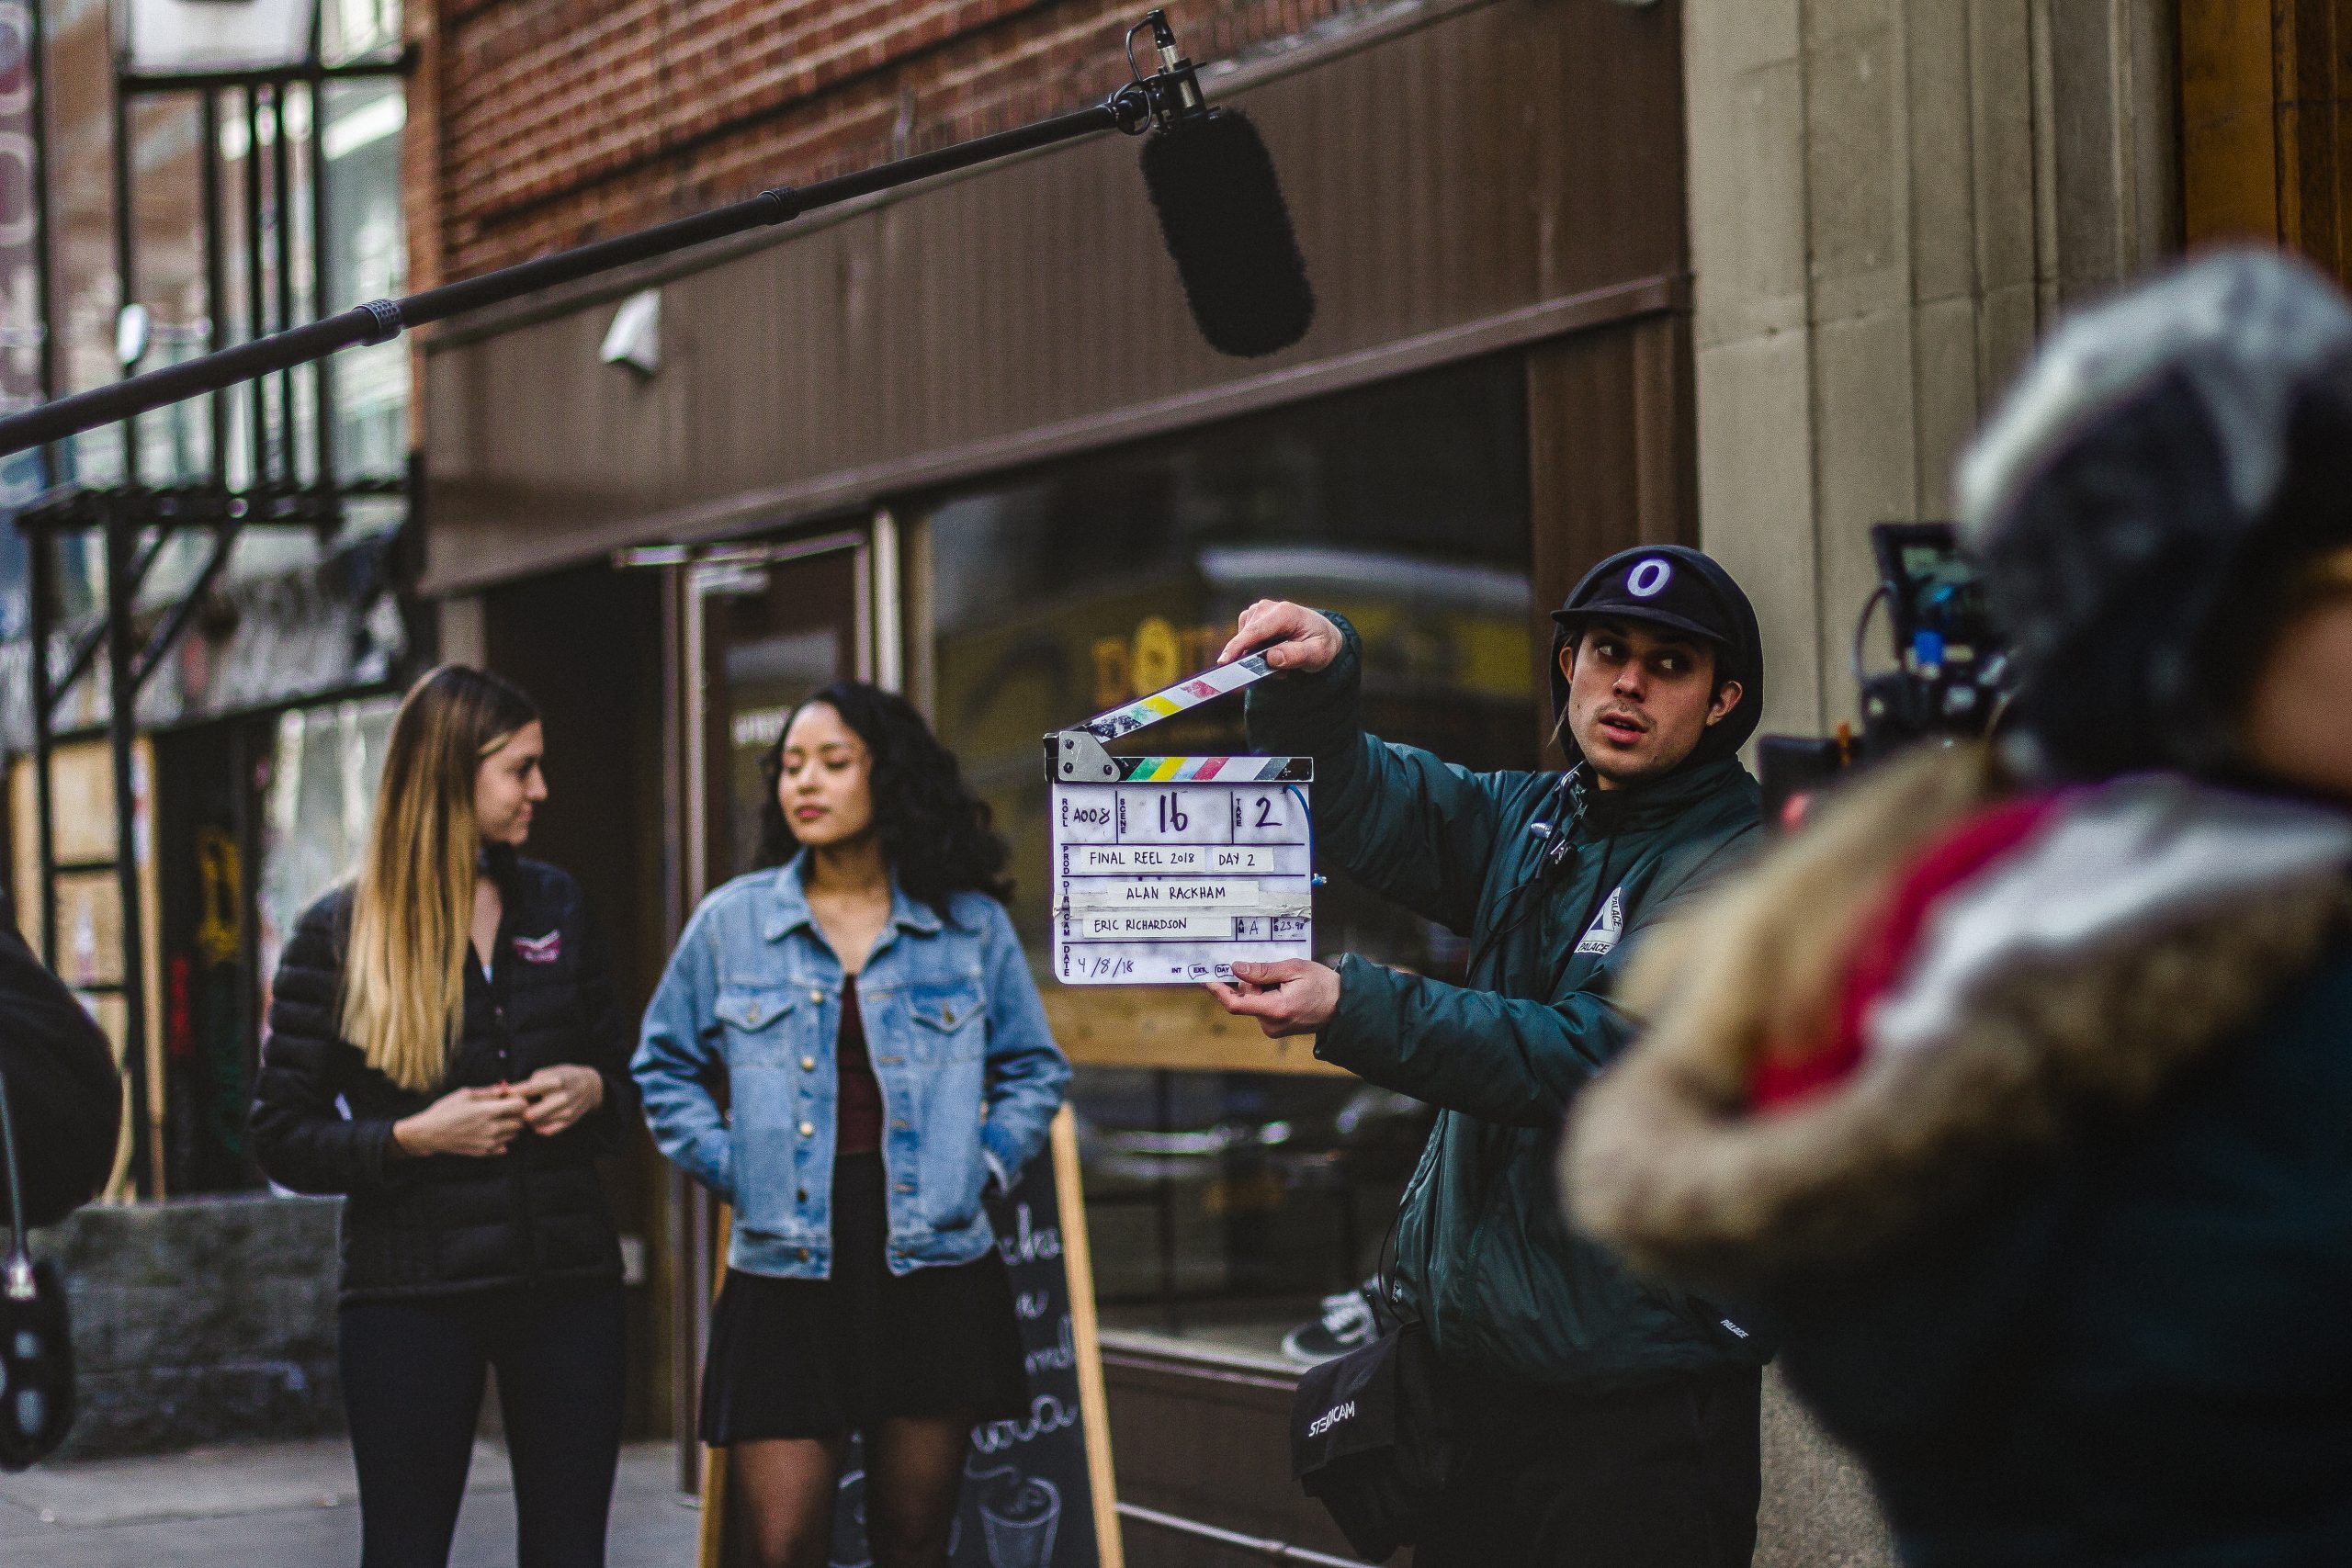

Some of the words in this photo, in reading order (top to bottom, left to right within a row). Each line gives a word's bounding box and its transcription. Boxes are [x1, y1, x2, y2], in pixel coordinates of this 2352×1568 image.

[1073, 807, 1111, 825] A008
[1159, 791, 1188, 833] 16
[1255, 796, 1283, 828] 2
[1062, 845, 1070, 874] PROD
[1090, 851, 1125, 865] FINAL
[1134, 851, 1163, 864] REEL
[1170, 852, 1195, 864] 2018
[1218, 852, 1239, 866] DAY
[1247, 853, 1256, 866] 2
[1126, 886, 1159, 900] ALAN
[1169, 886, 1226, 900] RACKHAM
[1611, 896, 1623, 928] PALACE
[1094, 919, 1119, 932] ERIC
[1125, 917, 1187, 931] RICHARDSON
[1250, 919, 1259, 936] A
[1577, 942, 1610, 953] PALACE
[1308, 1401, 1355, 1438] STEICAM
